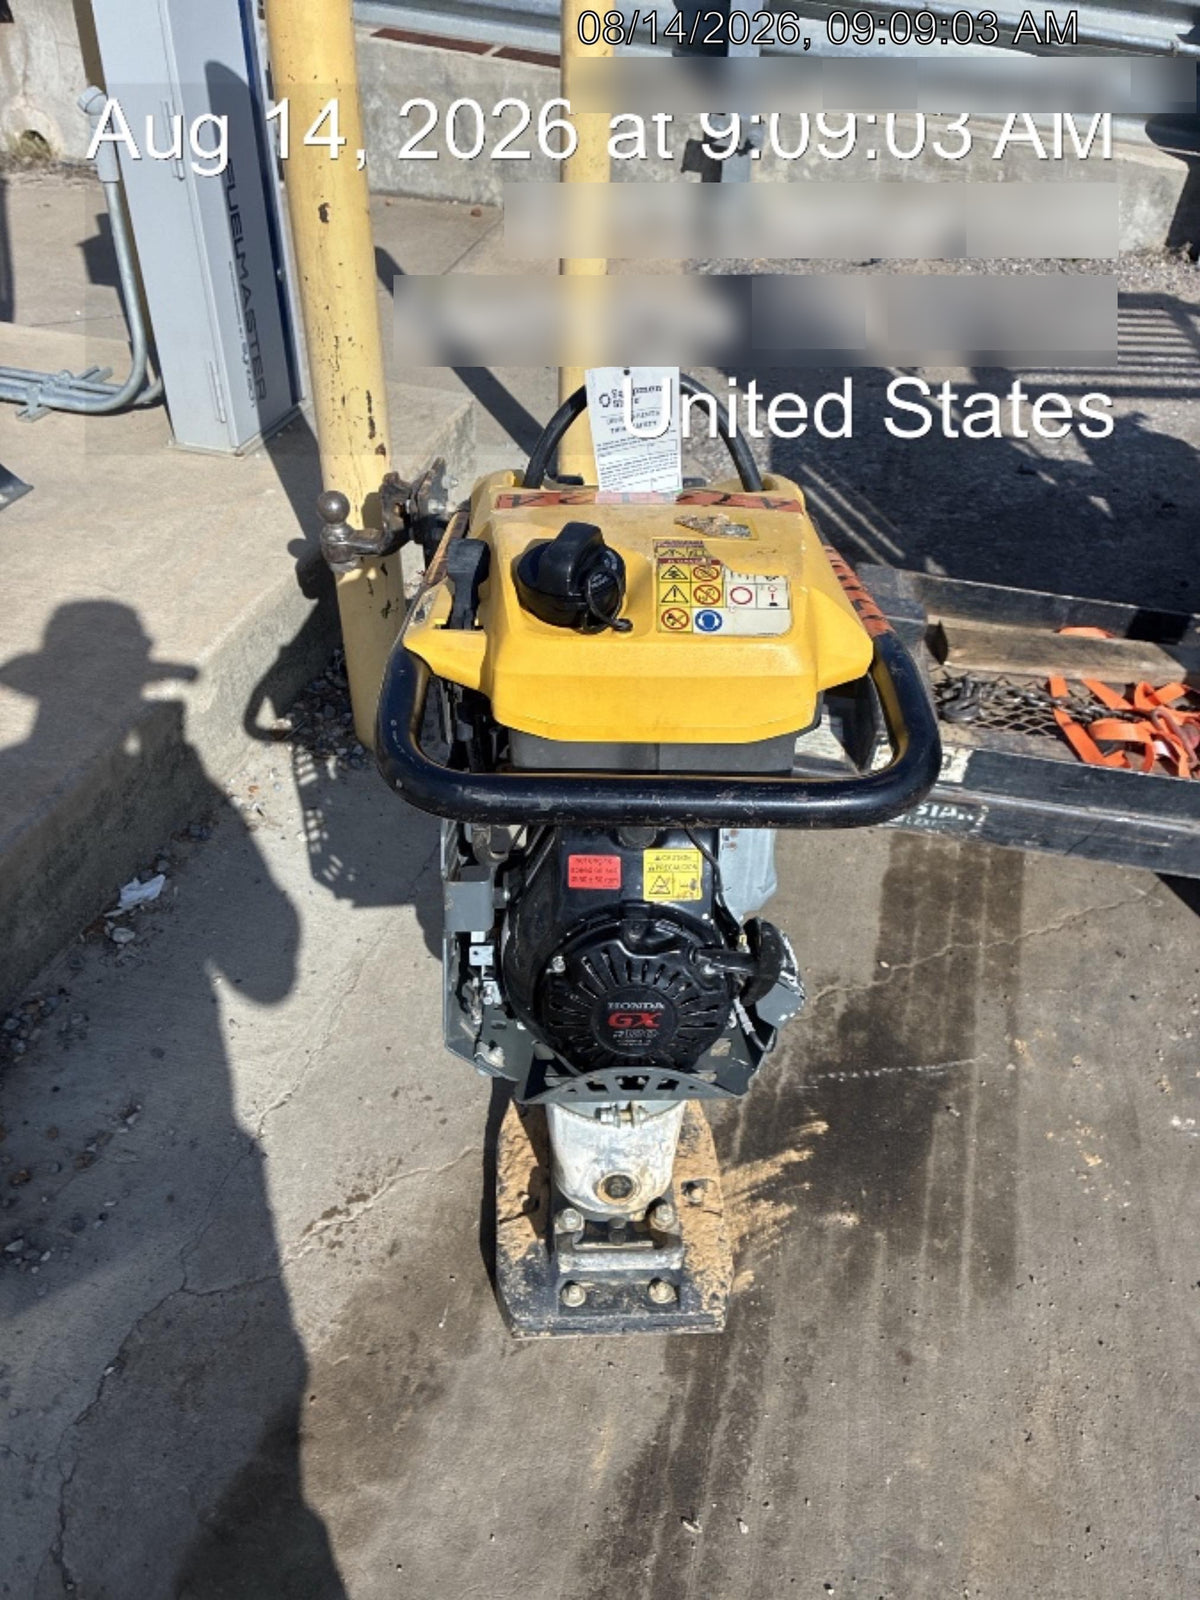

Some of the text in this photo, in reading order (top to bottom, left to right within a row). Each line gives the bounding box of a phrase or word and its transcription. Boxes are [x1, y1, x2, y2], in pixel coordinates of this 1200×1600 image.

[225, 157, 267, 400] FUELMASTER
[607, 1001, 665, 1009] HONDA
[607, 1012, 663, 1029] GX
